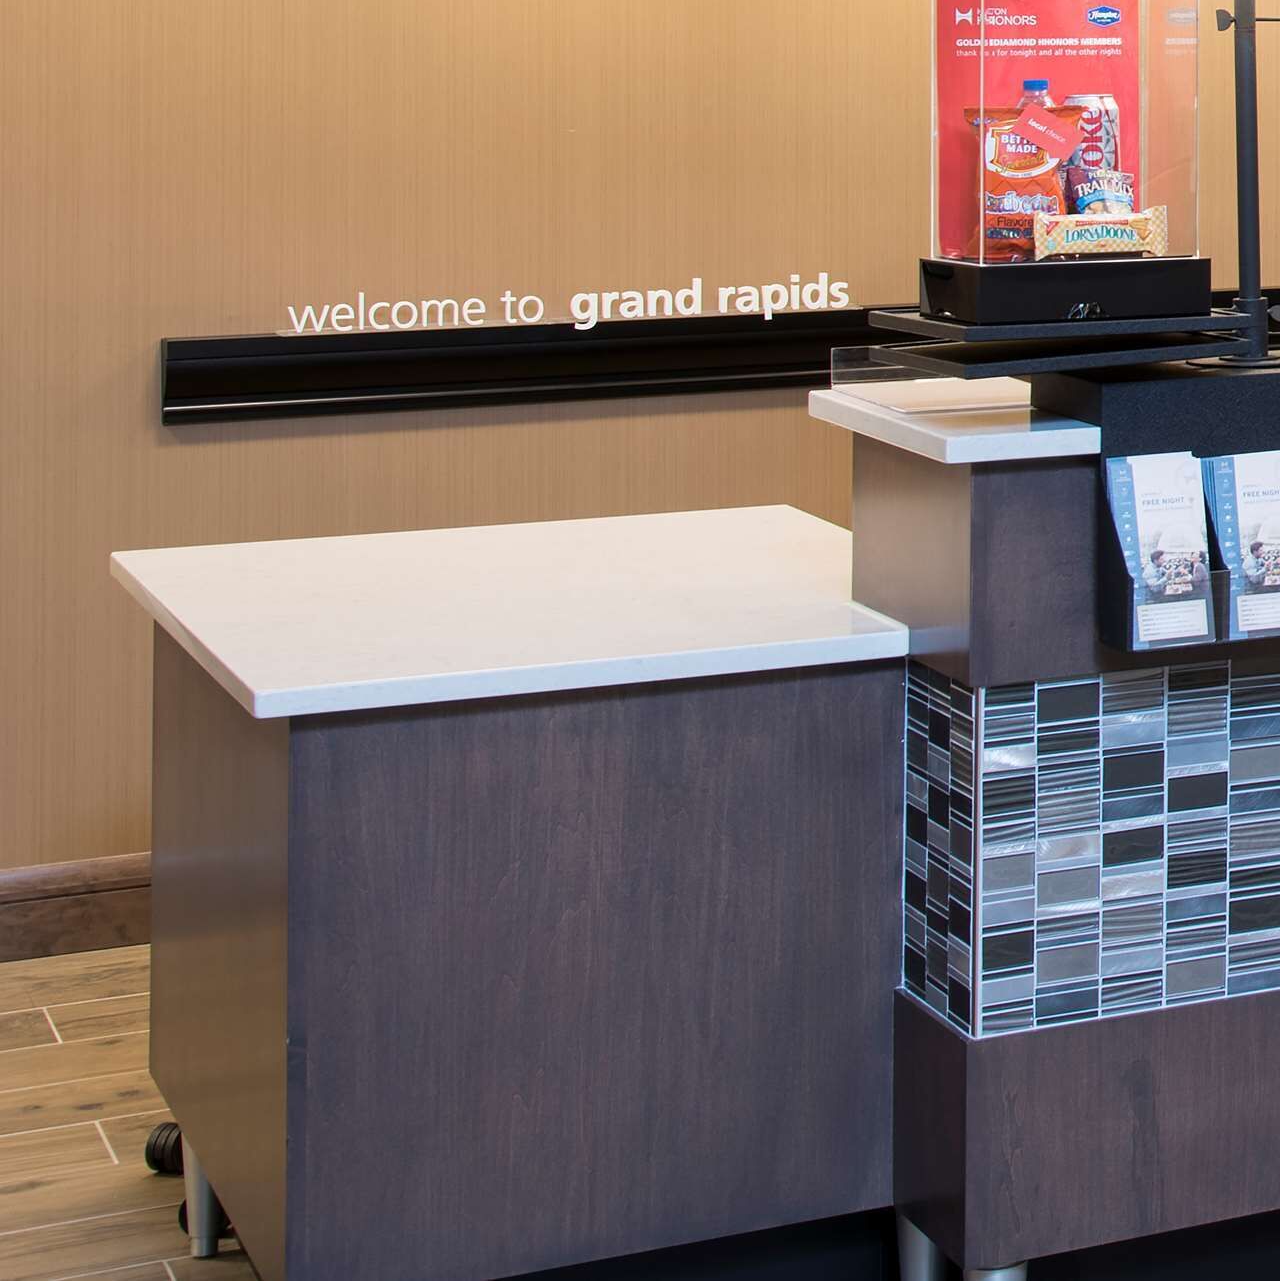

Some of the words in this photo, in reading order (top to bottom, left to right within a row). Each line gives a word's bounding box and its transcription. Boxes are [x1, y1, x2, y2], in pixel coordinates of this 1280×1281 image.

[956, 38, 980, 47] GOLD
[956, 49, 977, 57] thank
[1010, 49, 1037, 58] tonight
[1039, 48, 1052, 56] and
[1065, 48, 1077, 56] the
[1079, 48, 1098, 56] other
[1027, 118, 1047, 133] local
[1006, 145, 1039, 154] MADE
[1111, 177, 1135, 199] MIX
[997, 217, 1034, 227] Flavore
[287, 291, 487, 334] welcome
[500, 289, 545, 324] to
[570, 277, 703, 330] grand
[717, 272, 851, 321] rapids
